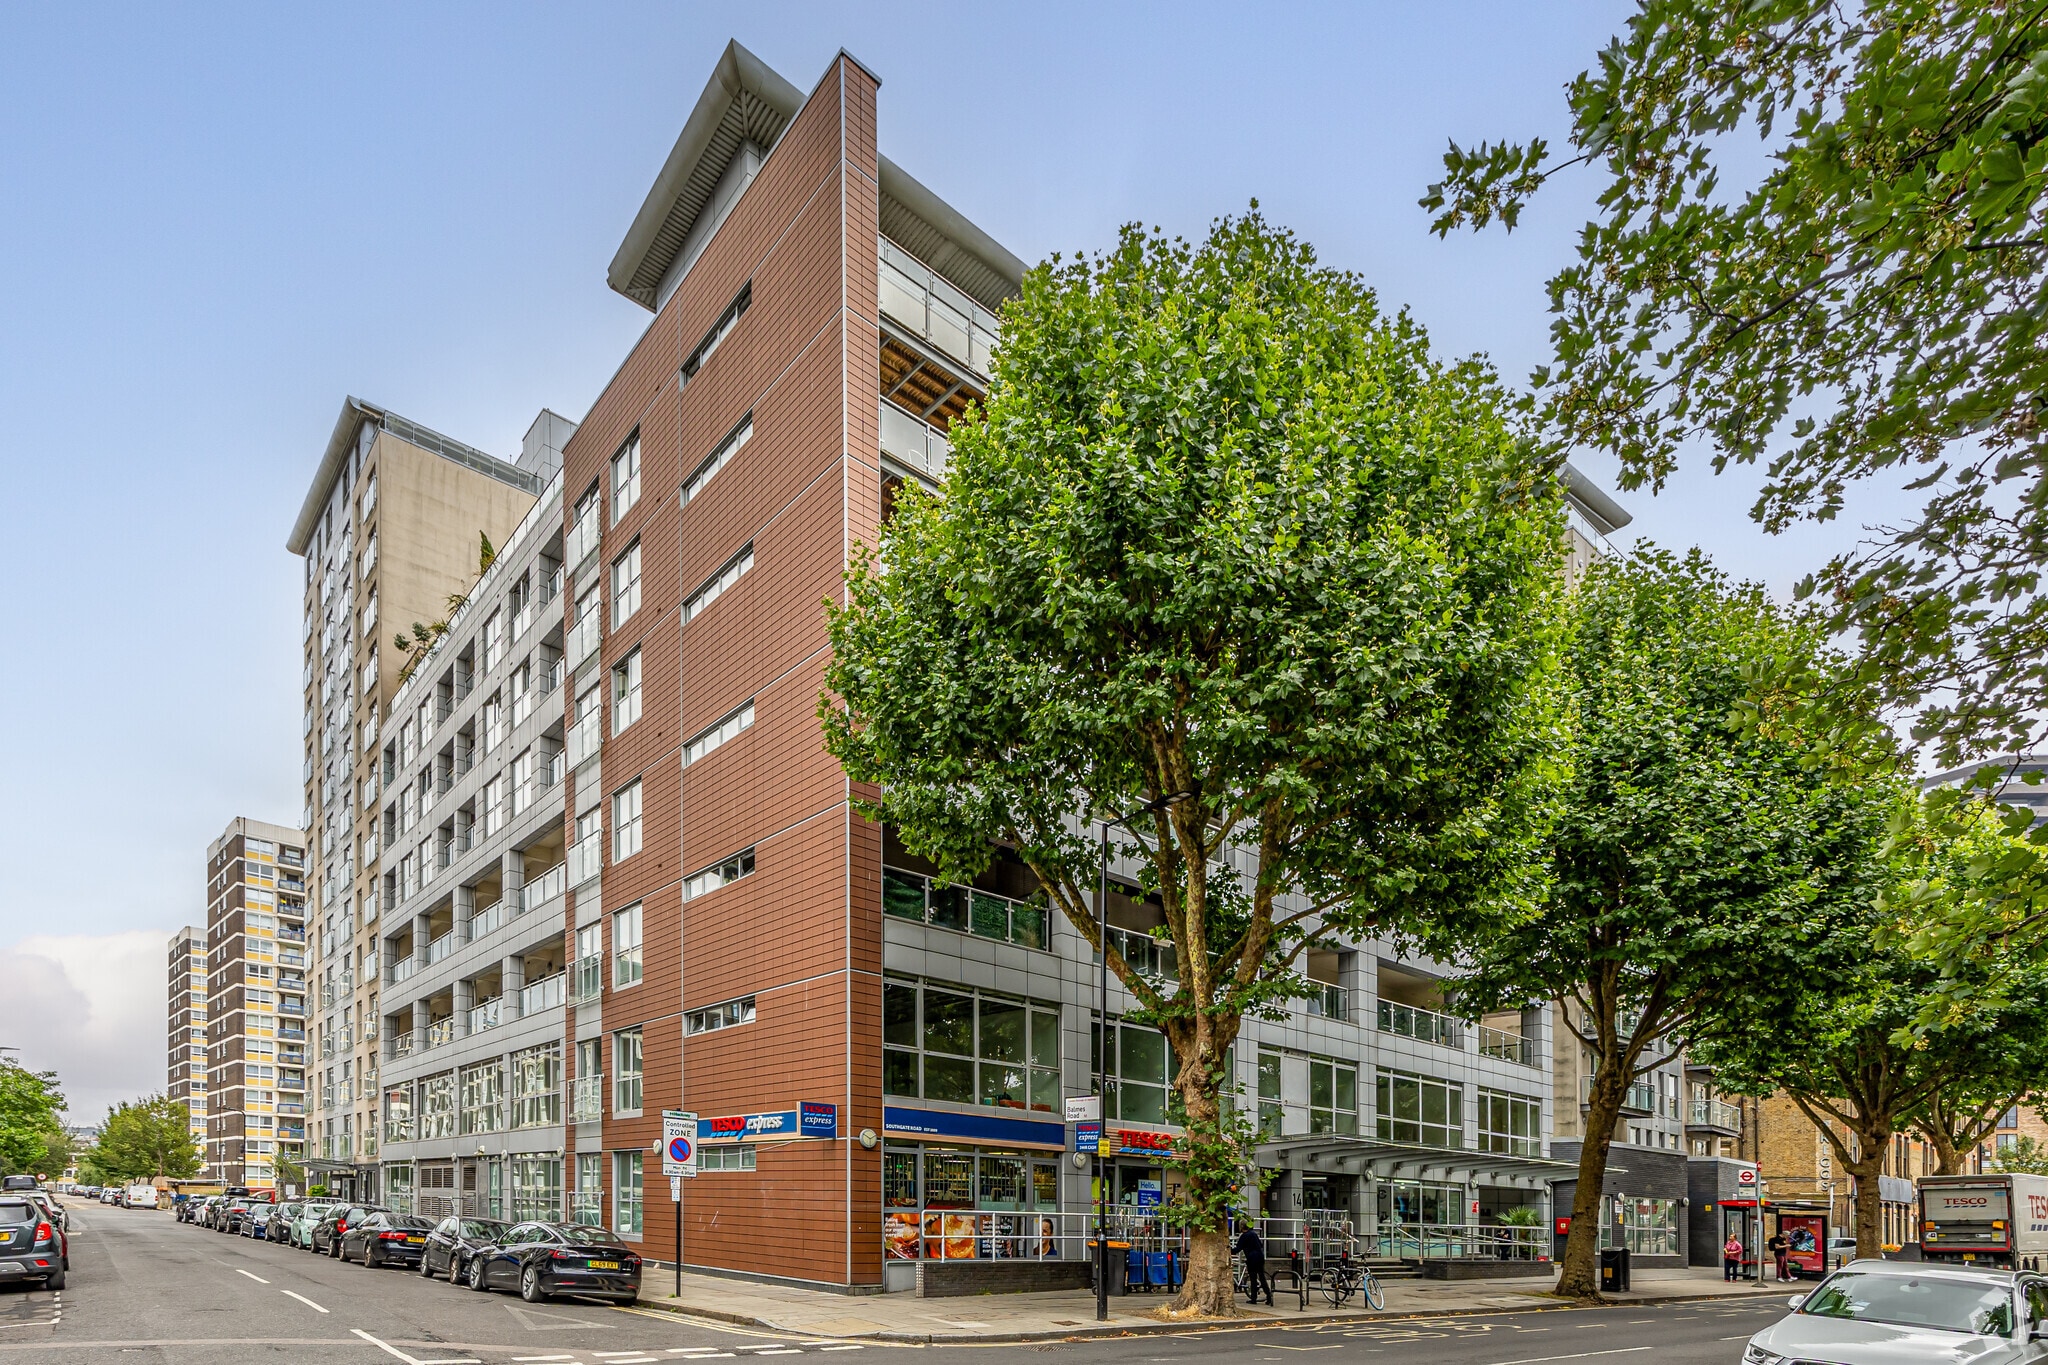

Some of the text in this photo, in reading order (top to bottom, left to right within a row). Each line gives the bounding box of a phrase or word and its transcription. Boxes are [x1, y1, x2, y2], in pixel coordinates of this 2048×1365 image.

[804, 1105, 834, 1115] TESCO
[665, 1121, 696, 1129] Controlled
[710, 1116, 783, 1133] TESCO express
[804, 1116, 832, 1125] express
[670, 1129, 691, 1137] ZONE
[1079, 1134, 1098, 1142] express
[1118, 1129, 1173, 1149] TESCO
[1293, 1193, 1302, 1206] 14
